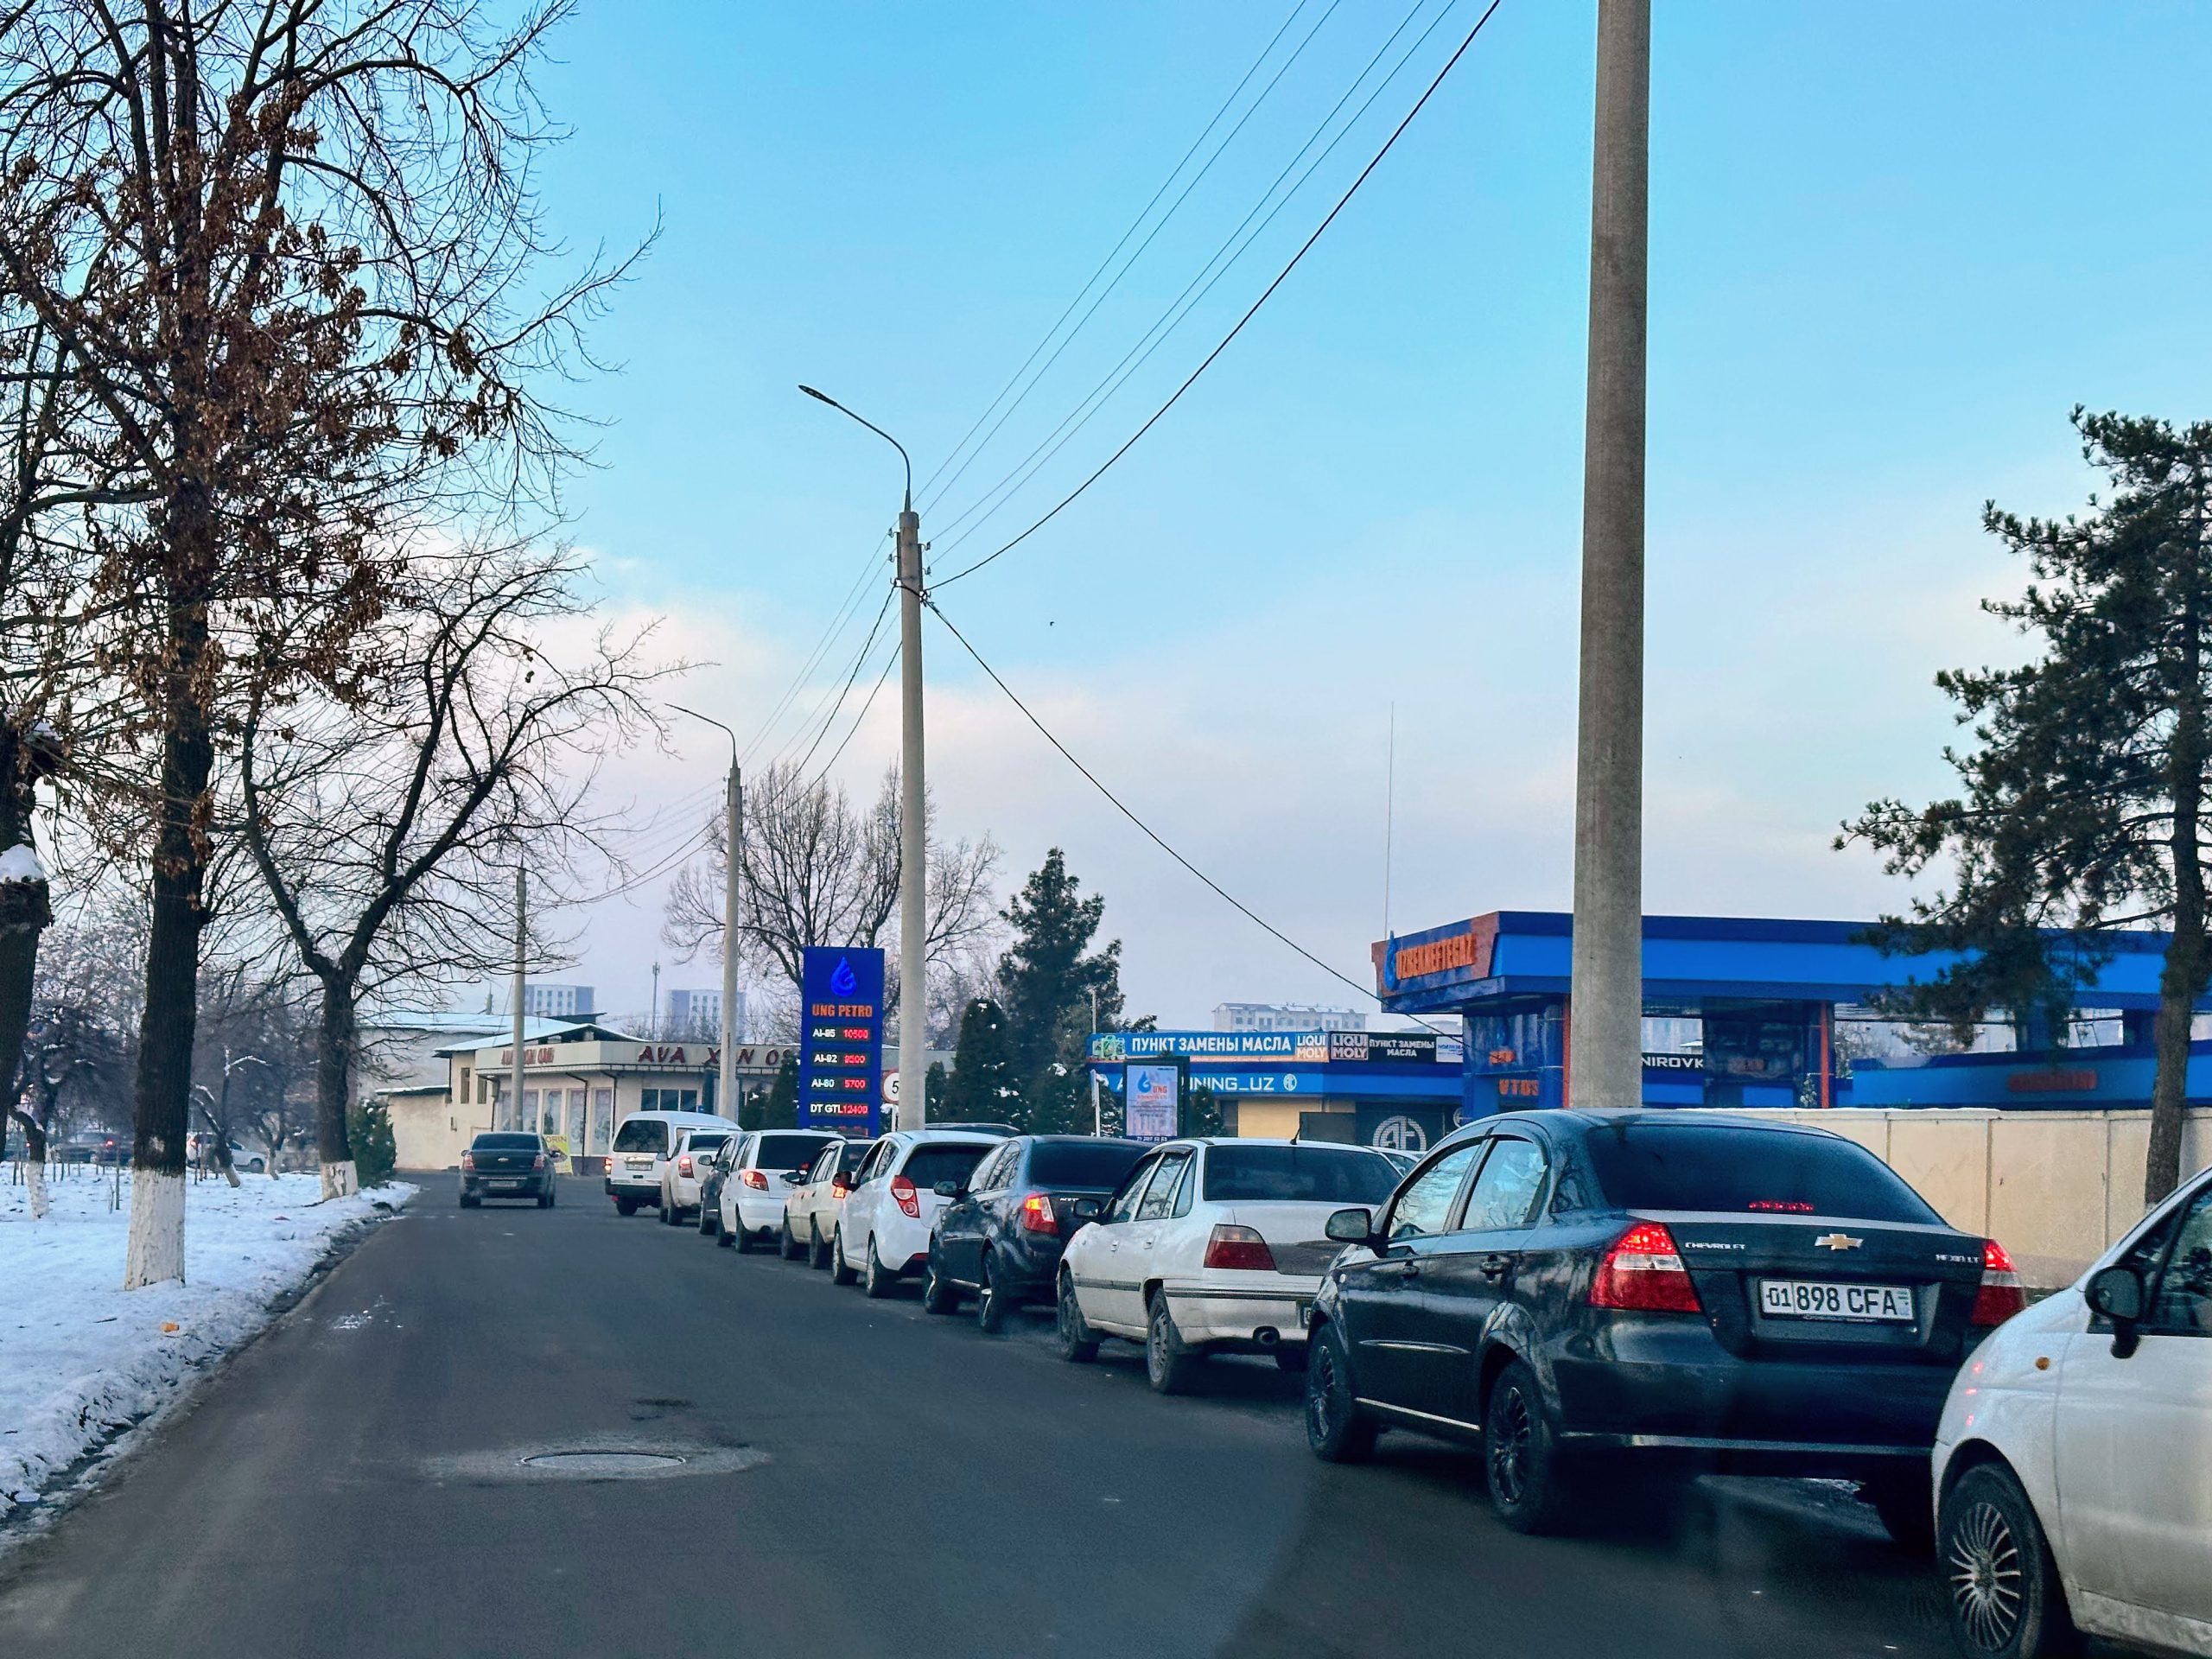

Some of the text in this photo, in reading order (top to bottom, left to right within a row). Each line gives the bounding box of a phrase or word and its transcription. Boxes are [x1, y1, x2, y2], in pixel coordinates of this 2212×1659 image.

[812, 1004, 873, 1017] UNG PETRO
[1132, 1036, 1292, 1052] ПУНКТ ЗАМЕНЫ МАСЛА
[1297, 1035, 1325, 1047] LIQUI
[1332, 1034, 1367, 1047] LIQUI
[1370, 1039, 1434, 1049] ПУНКТ ЗАМЕНЫ
[638, 1046, 685, 1063] AVA
[702, 1046, 754, 1065] XN
[814, 1053, 837, 1063] AI-92
[1297, 1046, 1327, 1058] MOLY
[1332, 1046, 1367, 1059] MOLY
[892, 1080, 899, 1094] 5
[1153, 1085, 1167, 1094] UNG
[1190, 1077, 1274, 1090] NING_UZ
[810, 1103, 823, 1113] DT
[824, 1103, 843, 1114] GTL
[1685, 1242, 1746, 1250] CHEVROLET
[1769, 1285, 1897, 1315] 01 898 CFA
